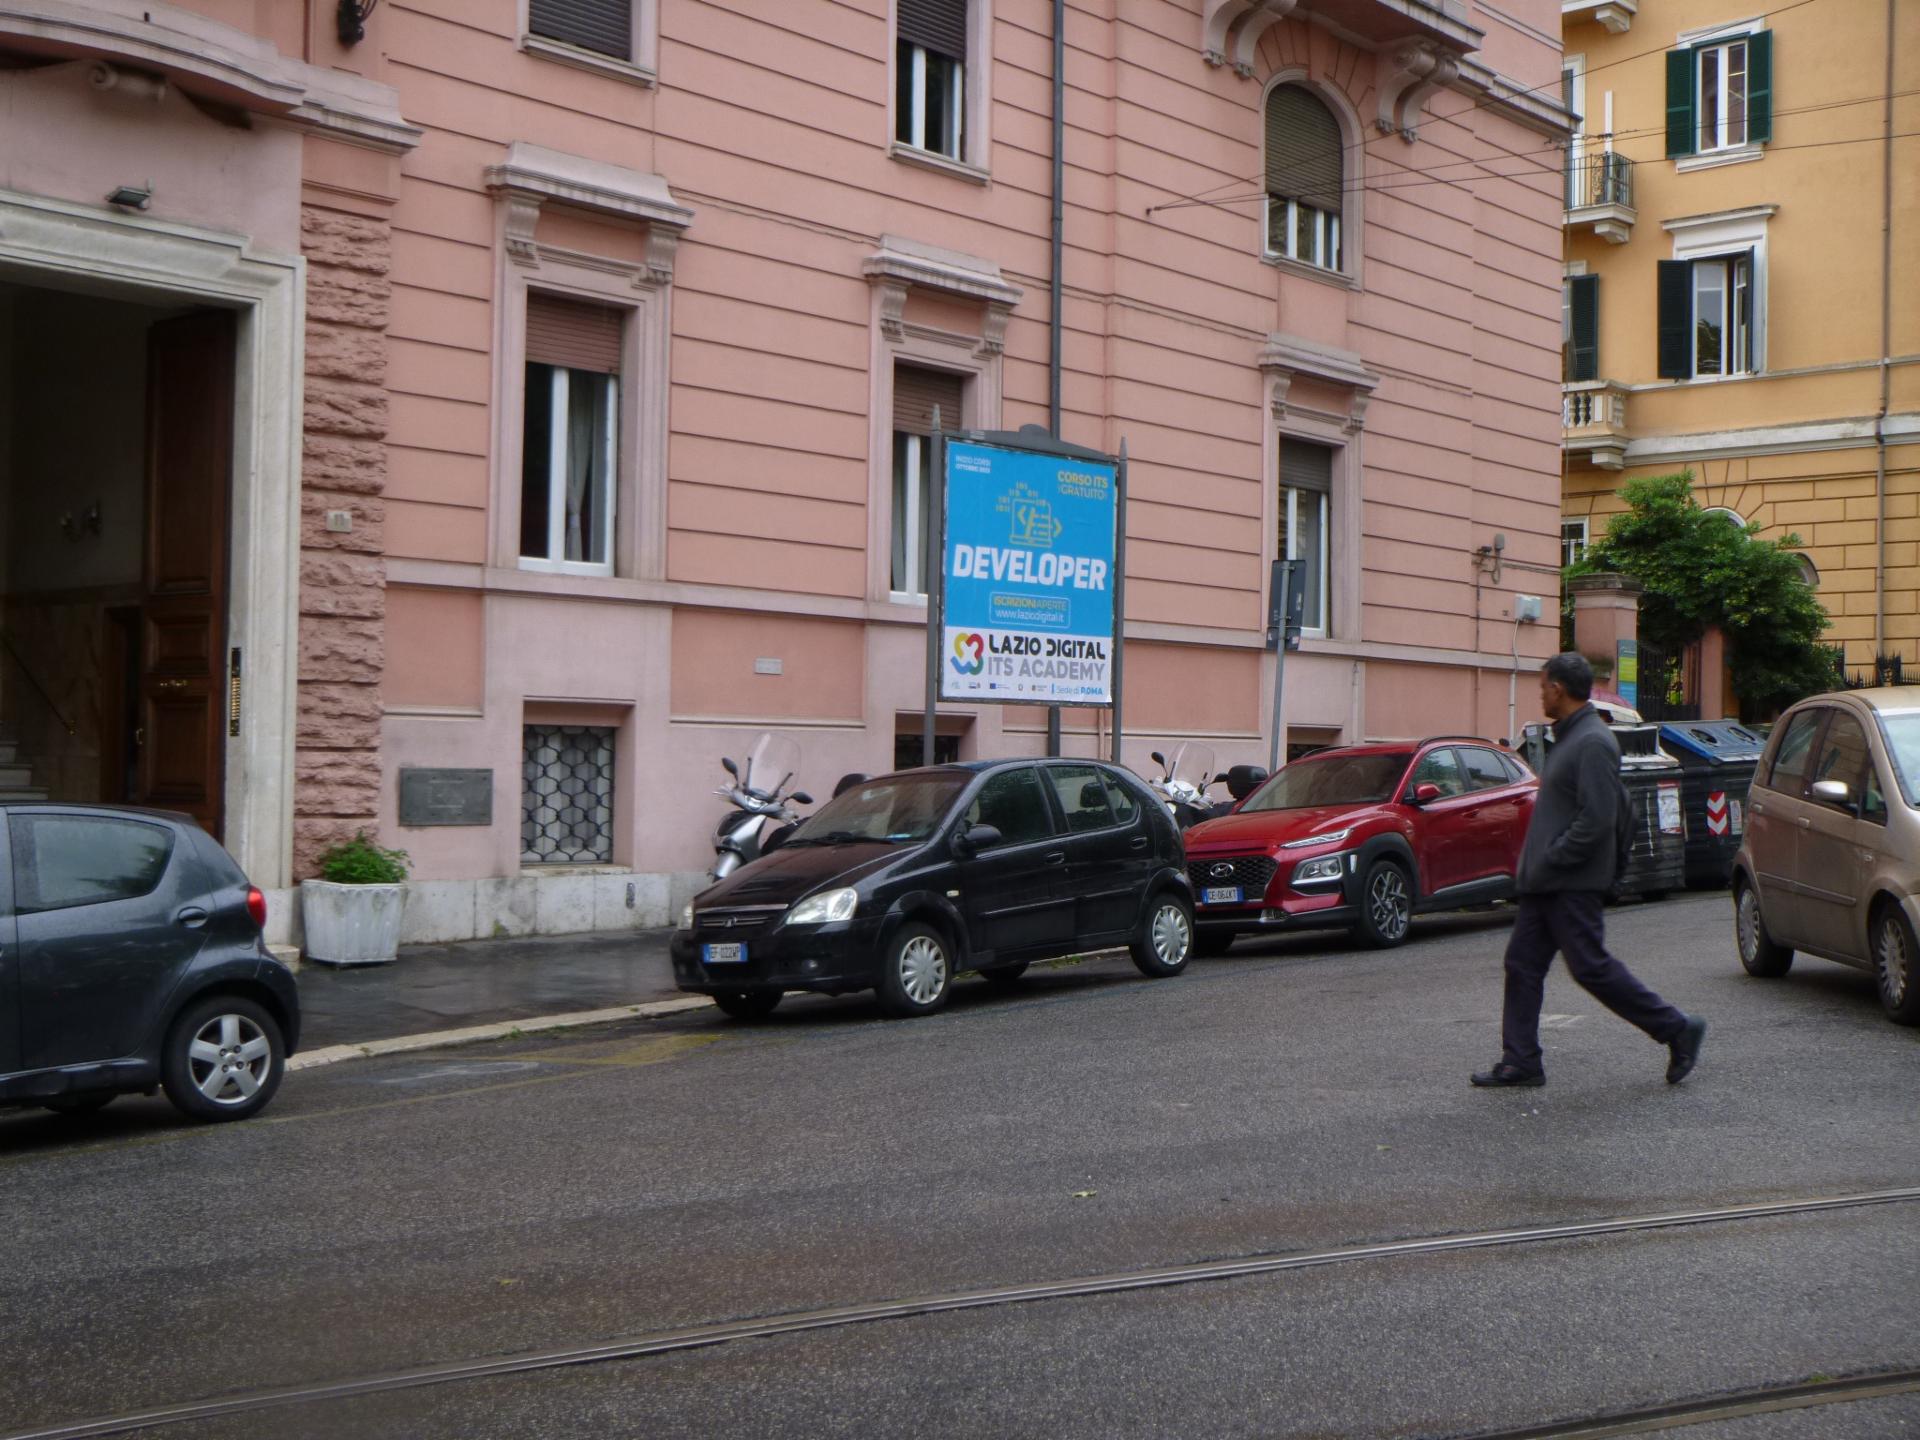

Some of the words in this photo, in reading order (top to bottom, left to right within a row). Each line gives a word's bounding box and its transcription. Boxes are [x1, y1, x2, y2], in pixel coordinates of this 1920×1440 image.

[1057, 471, 1092, 485] CORSO
[1093, 475, 1108, 489] ITS
[953, 545, 1107, 591] DEVELOPER
[988, 634, 1042, 655] LAZIO
[1046, 638, 1106, 660] DIGITAL
[988, 657, 1014, 676] ITS
[1019, 660, 1106, 681] ACADEMY
[1081, 687, 1103, 695] ROMA
